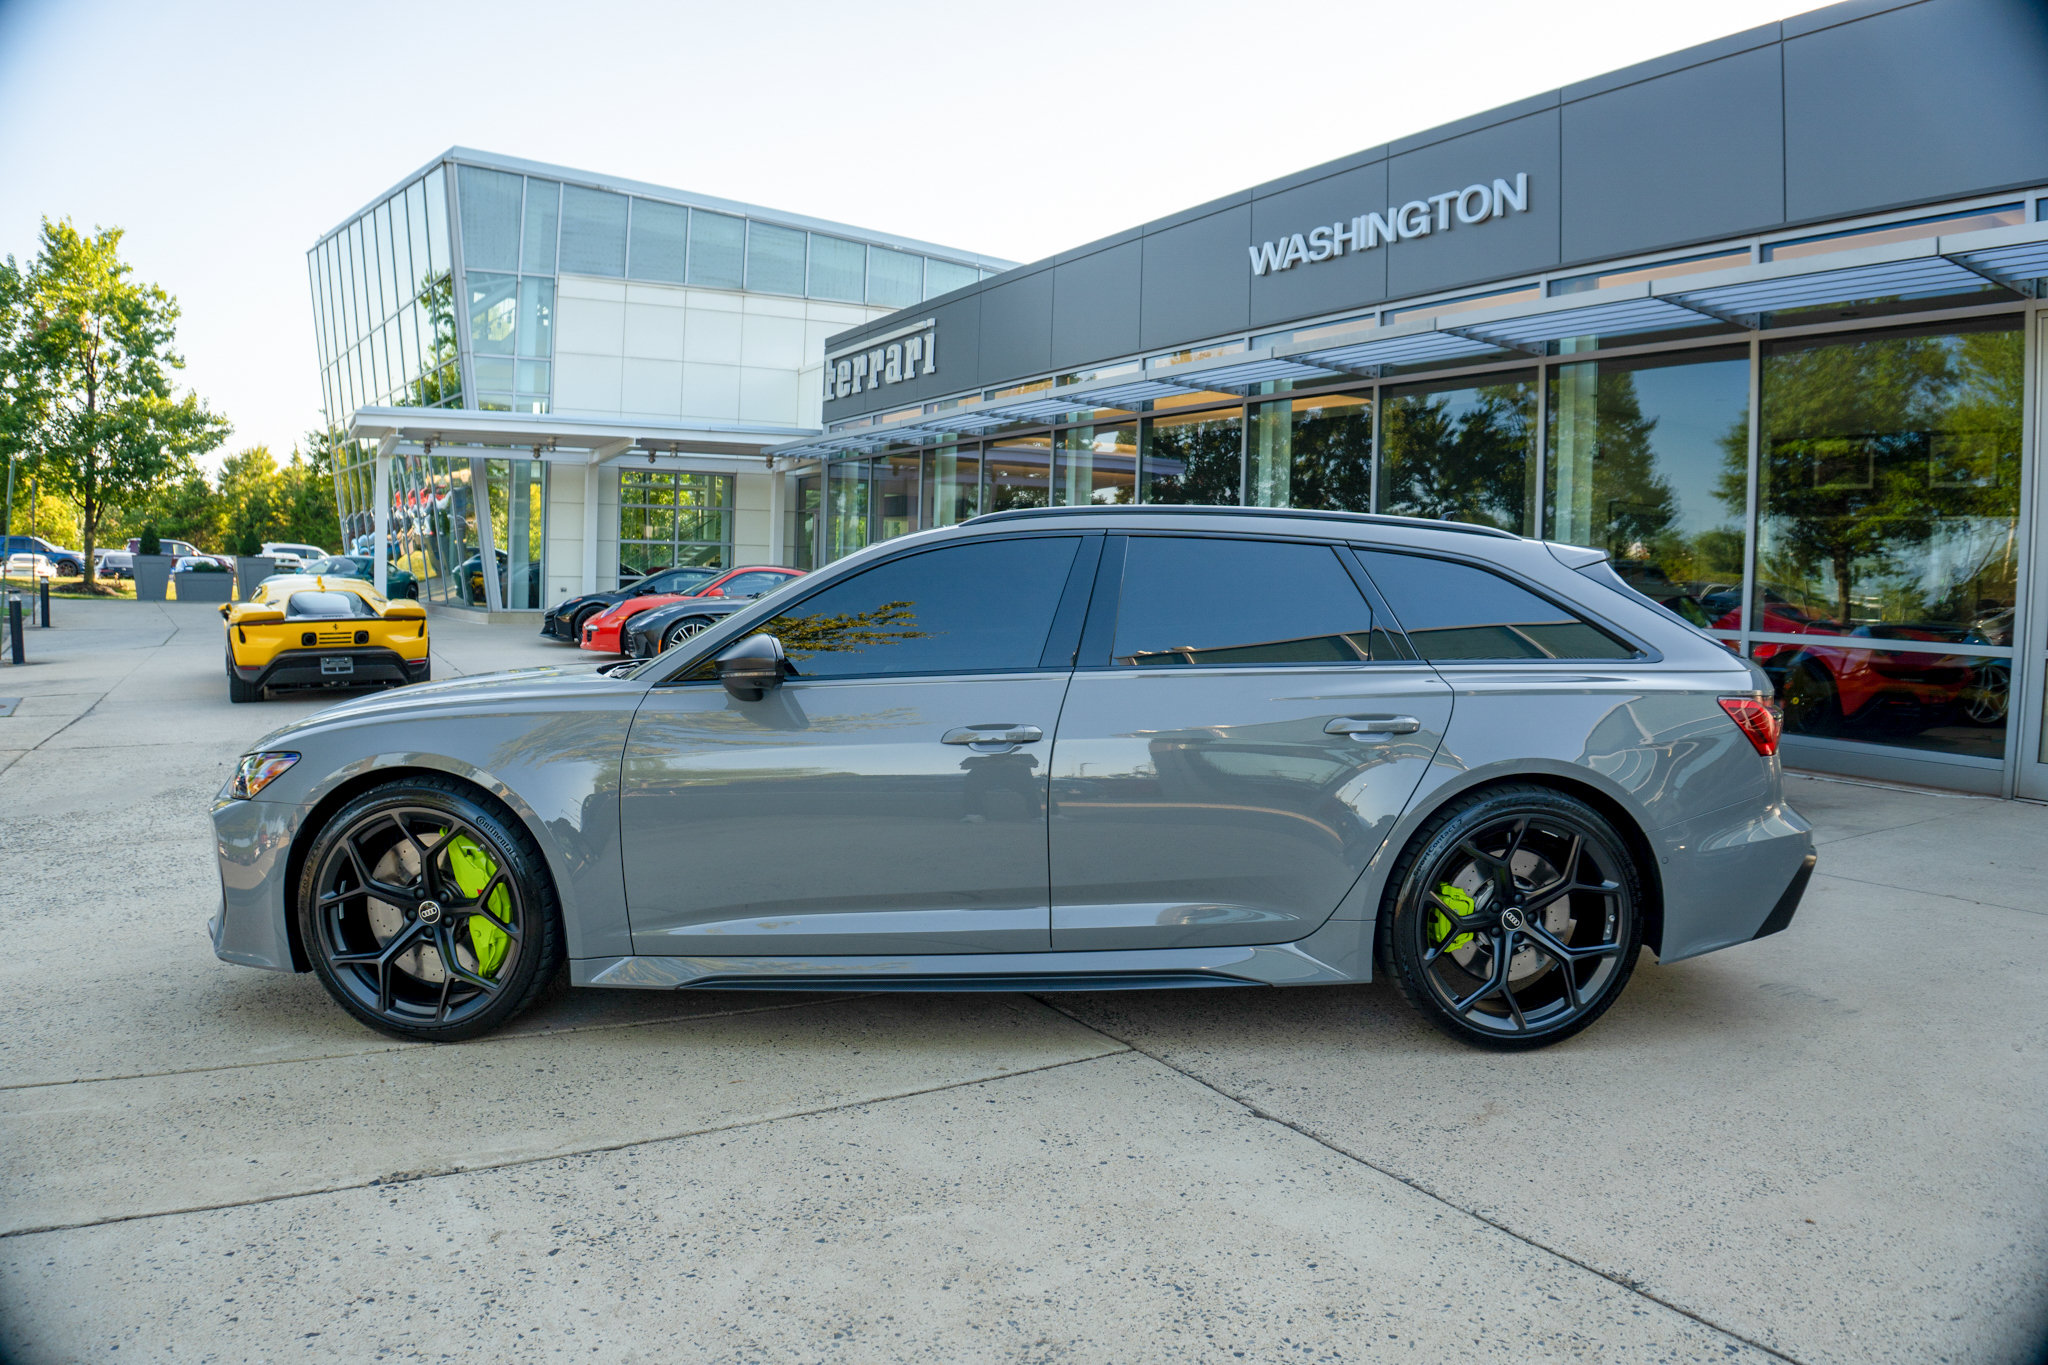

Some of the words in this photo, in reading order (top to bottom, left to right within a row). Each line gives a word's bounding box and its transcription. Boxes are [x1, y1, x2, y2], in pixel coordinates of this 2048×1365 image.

[1248, 172, 1528, 276] WASHINGTON
[823, 317, 936, 402] Ferrari
[475, 815, 514, 856] Continental
